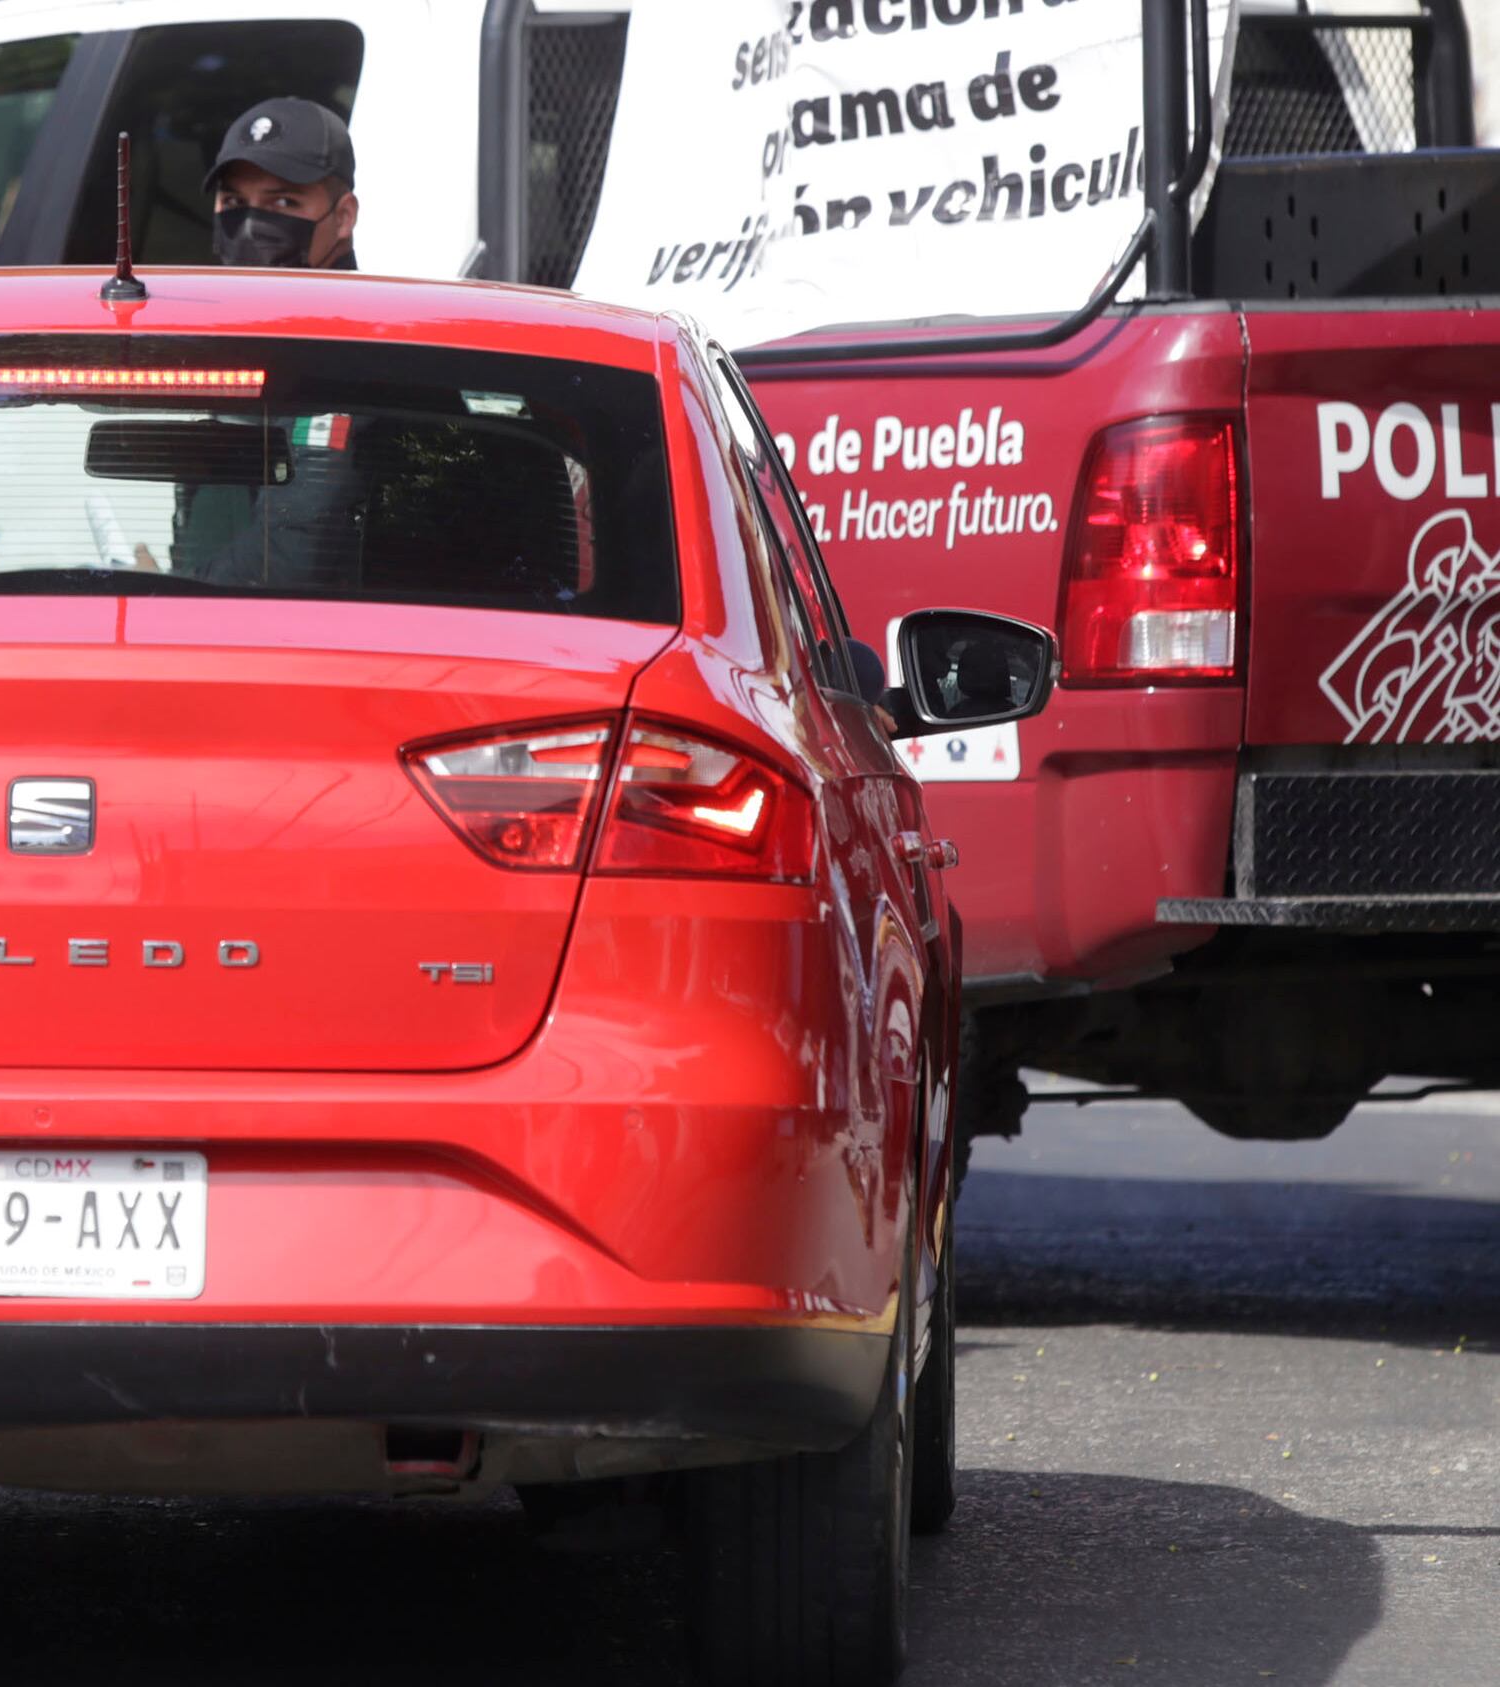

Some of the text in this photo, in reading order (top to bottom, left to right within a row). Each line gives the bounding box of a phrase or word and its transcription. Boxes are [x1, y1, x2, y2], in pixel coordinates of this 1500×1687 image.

[968, 51, 1061, 122] de
[887, 124, 1145, 227] vehicul
[808, 415, 862, 475] de
[872, 406, 1024, 472] Puebla
[839, 489, 942, 541] Hacer
[944, 482, 1058, 551] futuro.
[14, 1157, 92, 1178] CDMX
